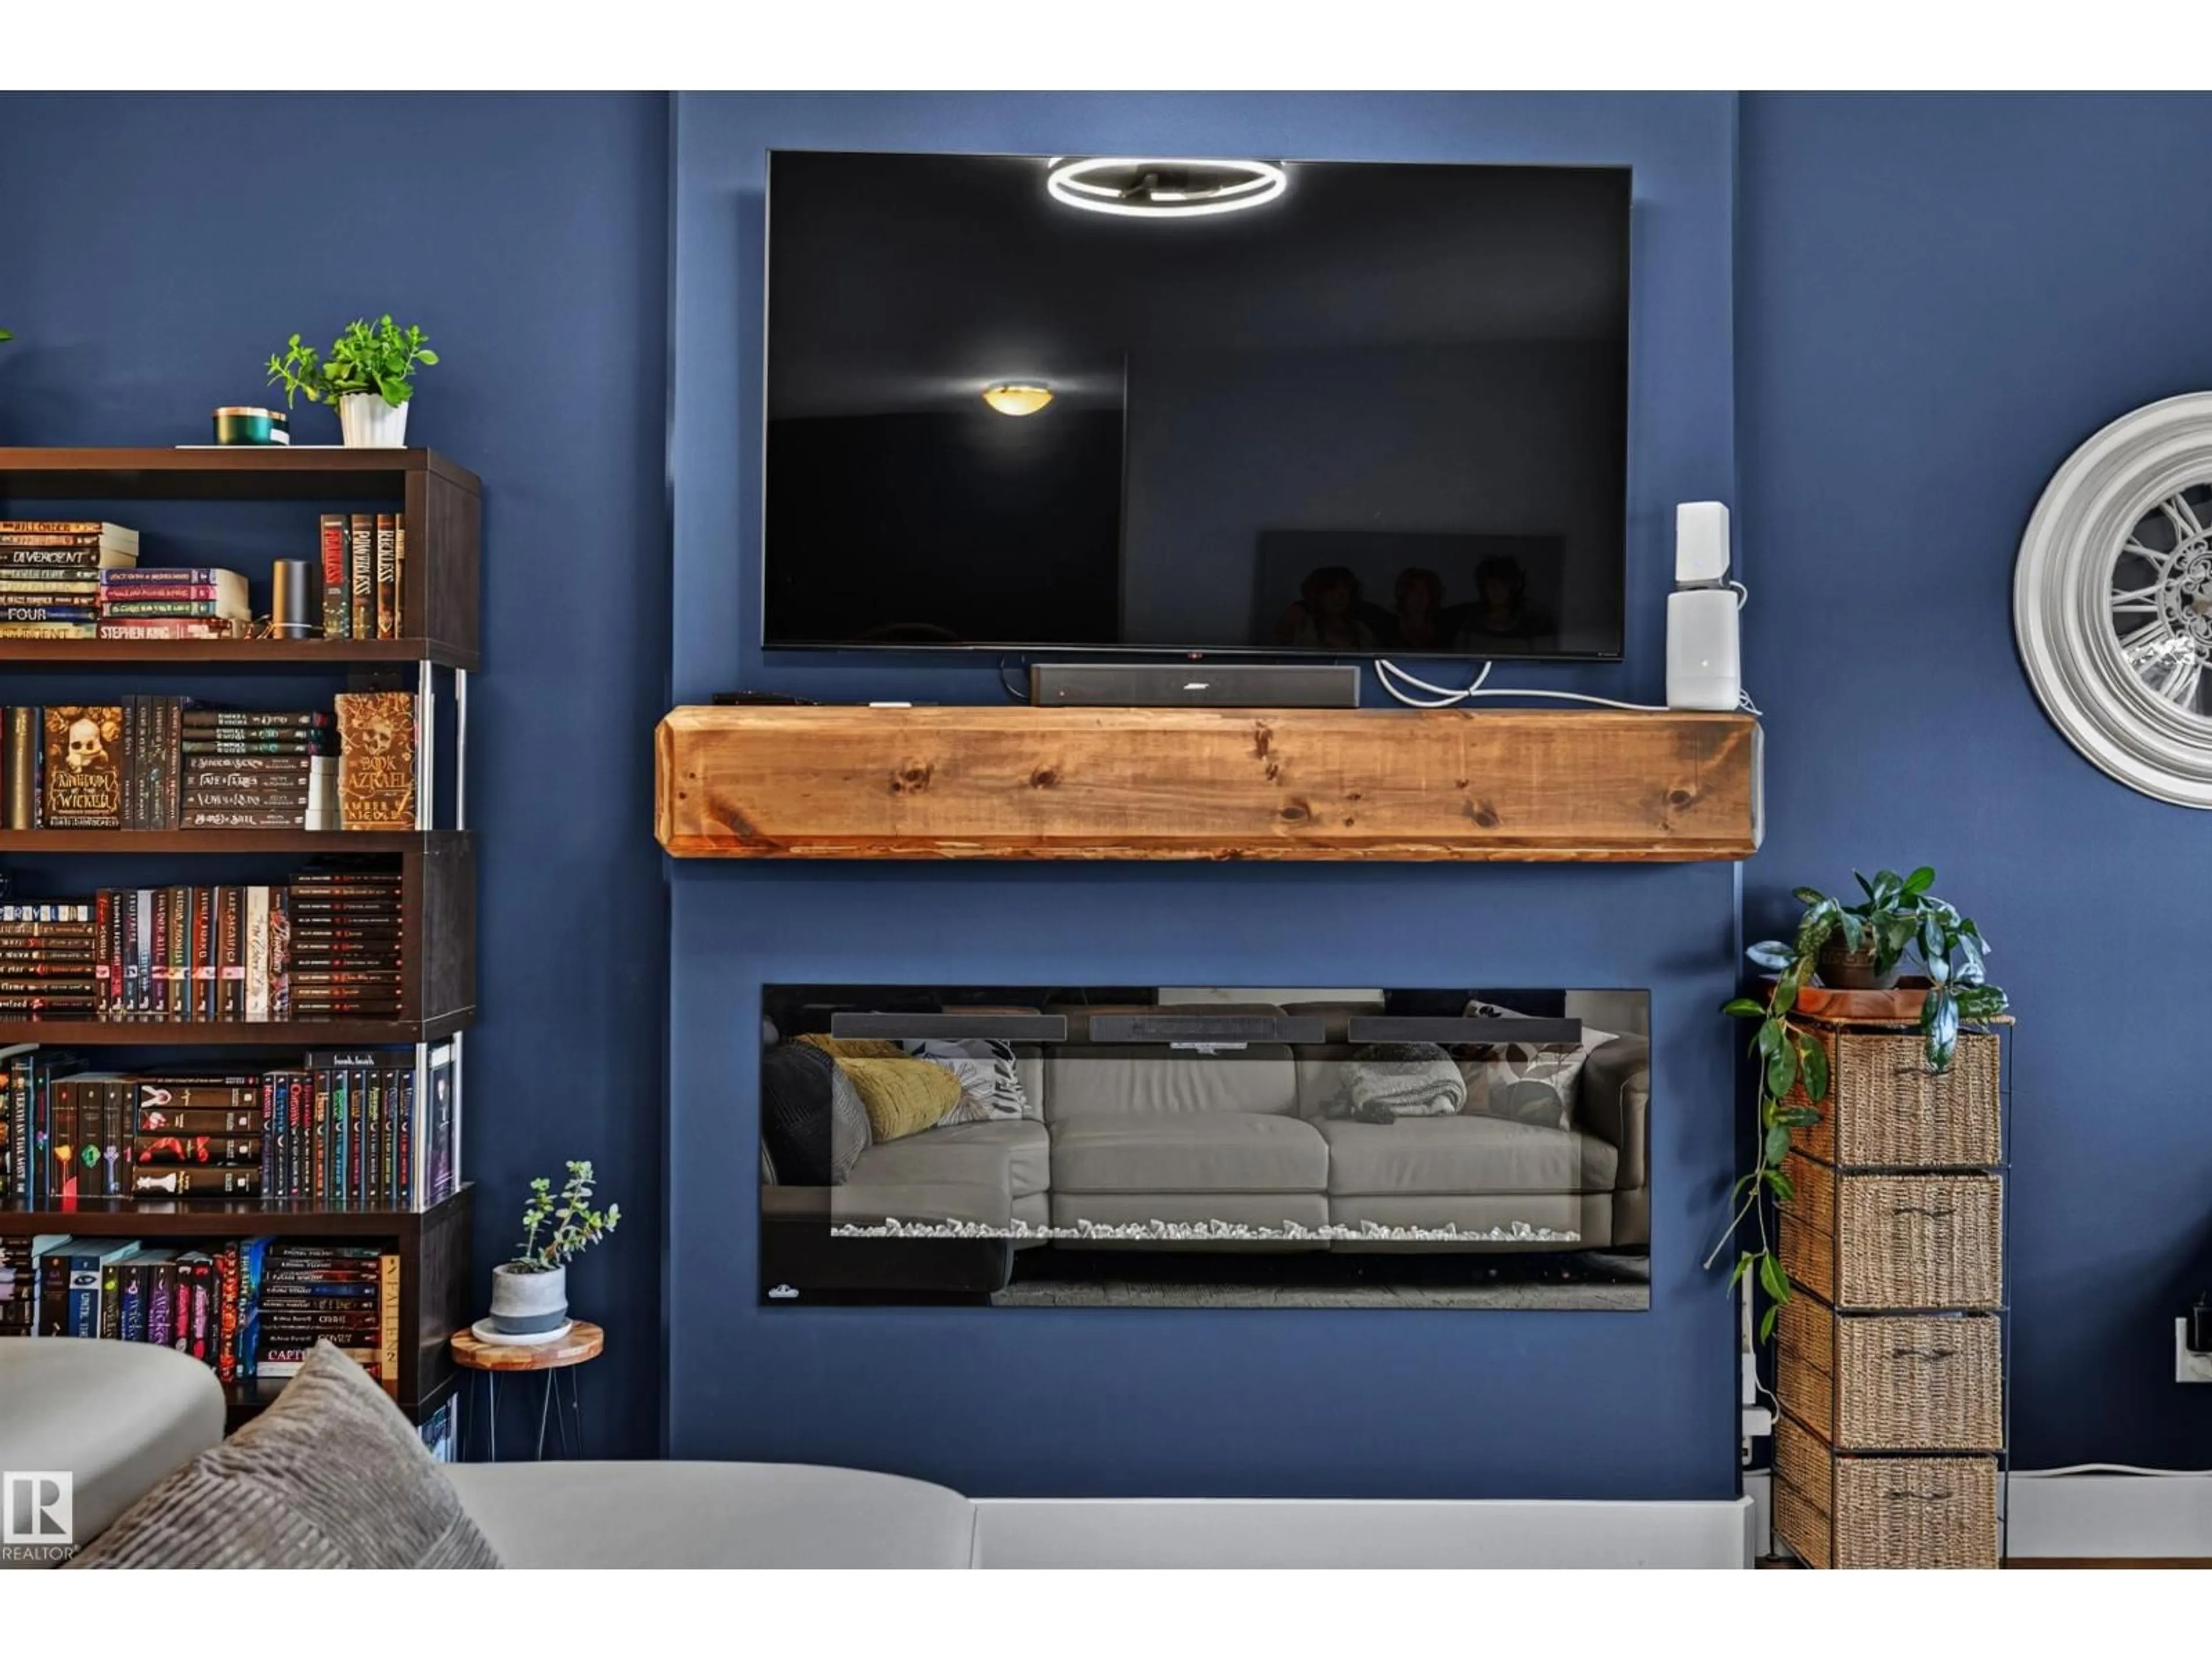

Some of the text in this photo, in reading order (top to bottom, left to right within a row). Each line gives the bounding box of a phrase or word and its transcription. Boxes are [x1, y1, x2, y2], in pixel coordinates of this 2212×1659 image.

[13, 551, 84, 563] DIVERGENT
[377, 529, 395, 584] RECKLESS
[8, 608, 47, 620] FOUR
[100, 626, 145, 639] STEPHEN
[361, 755, 396, 770] BOOK
